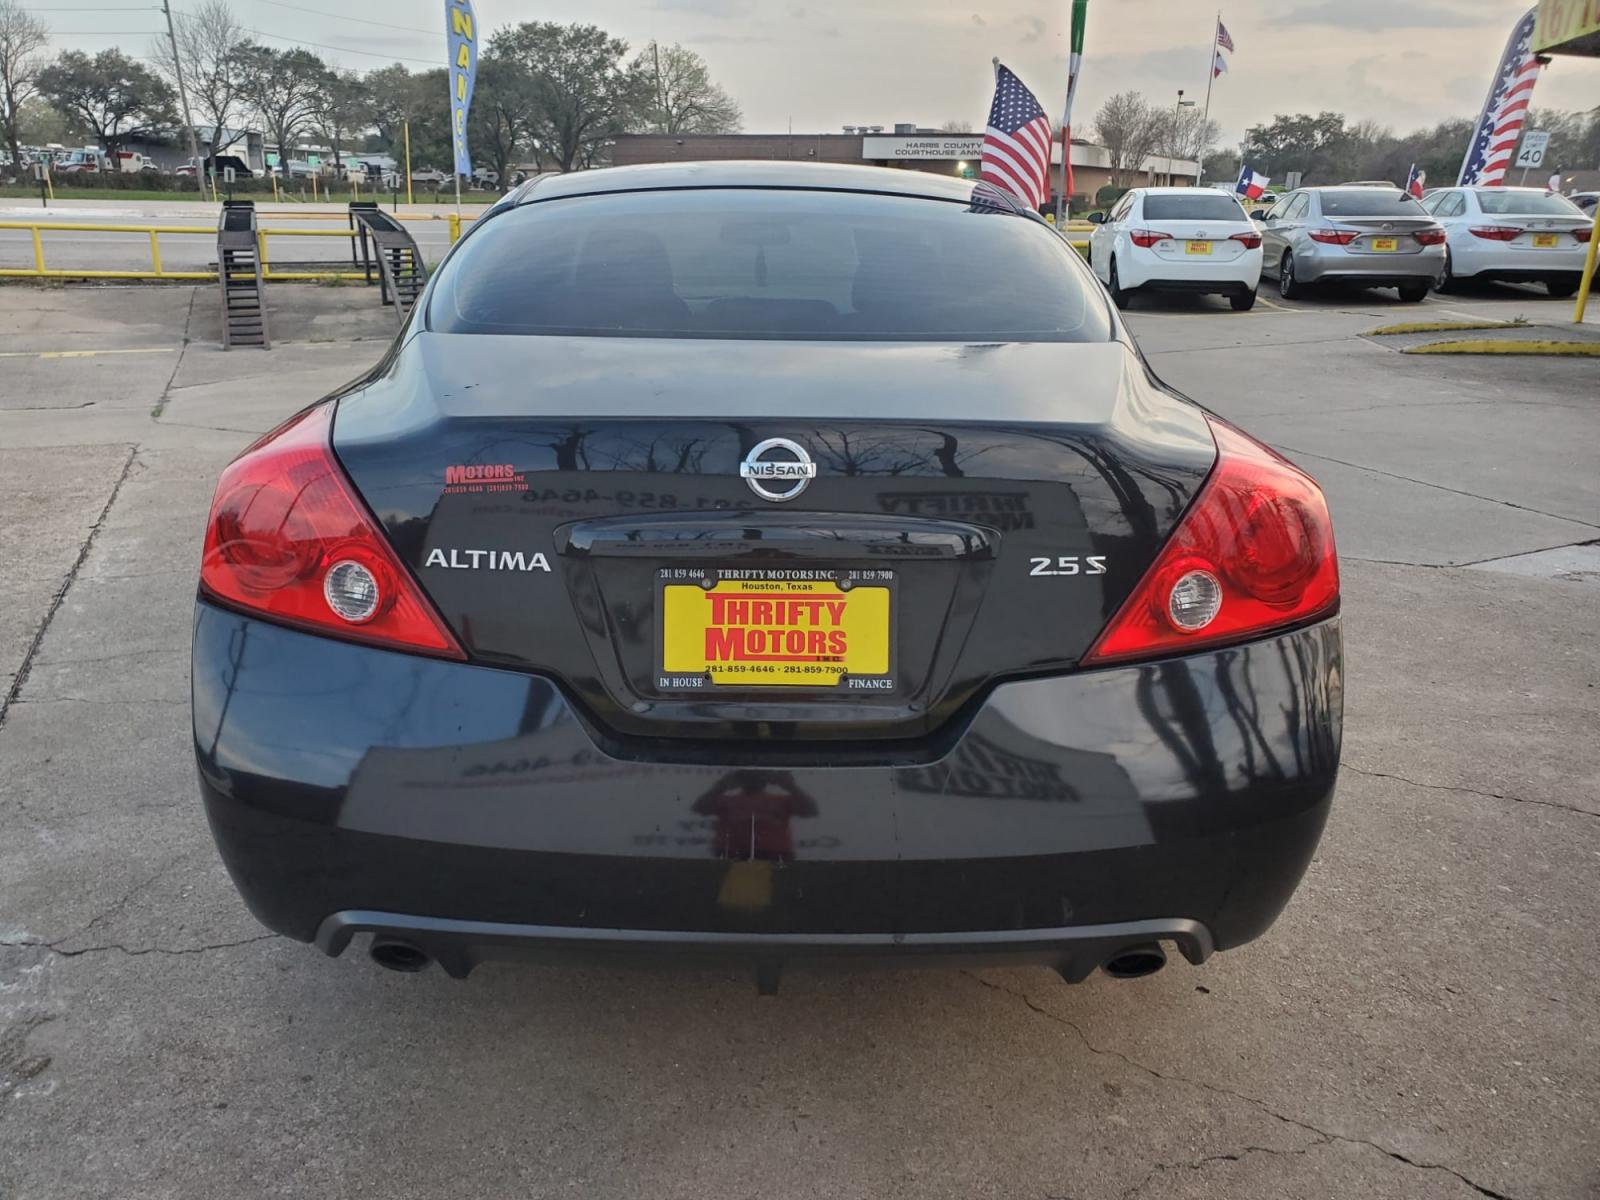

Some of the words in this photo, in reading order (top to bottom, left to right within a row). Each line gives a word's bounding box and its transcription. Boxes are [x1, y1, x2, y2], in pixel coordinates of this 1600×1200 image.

[1519, 150, 1542, 163] 40
[446, 464, 514, 484] MOTORS
[748, 465, 808, 476] NISSAN
[425, 548, 552, 572] ALTIMA
[1029, 556, 1079, 576] 2.5
[1085, 556, 1107, 575] S
[660, 568, 672, 578] 281
[674, 568, 687, 578] 859
[689, 568, 705, 578] 4646
[717, 569, 766, 579] THRIFTY
[767, 570, 813, 580] MOTORS
[815, 570, 838, 580] INC.
[848, 570, 860, 580] 281
[862, 570, 875, 580] 859
[877, 570, 893, 580] 7900
[741, 582, 784, 592] Houston,
[786, 583, 813, 591] Texas
[705, 593, 848, 626] THRIFTY
[705, 628, 847, 661] MOTORS
[705, 665, 775, 673] 281-859-4646
[784, 665, 848, 674] 281-859-7900
[659, 678, 670, 688] IN
[672, 678, 704, 688] HOUSE
[848, 679, 893, 689] FINANCE
